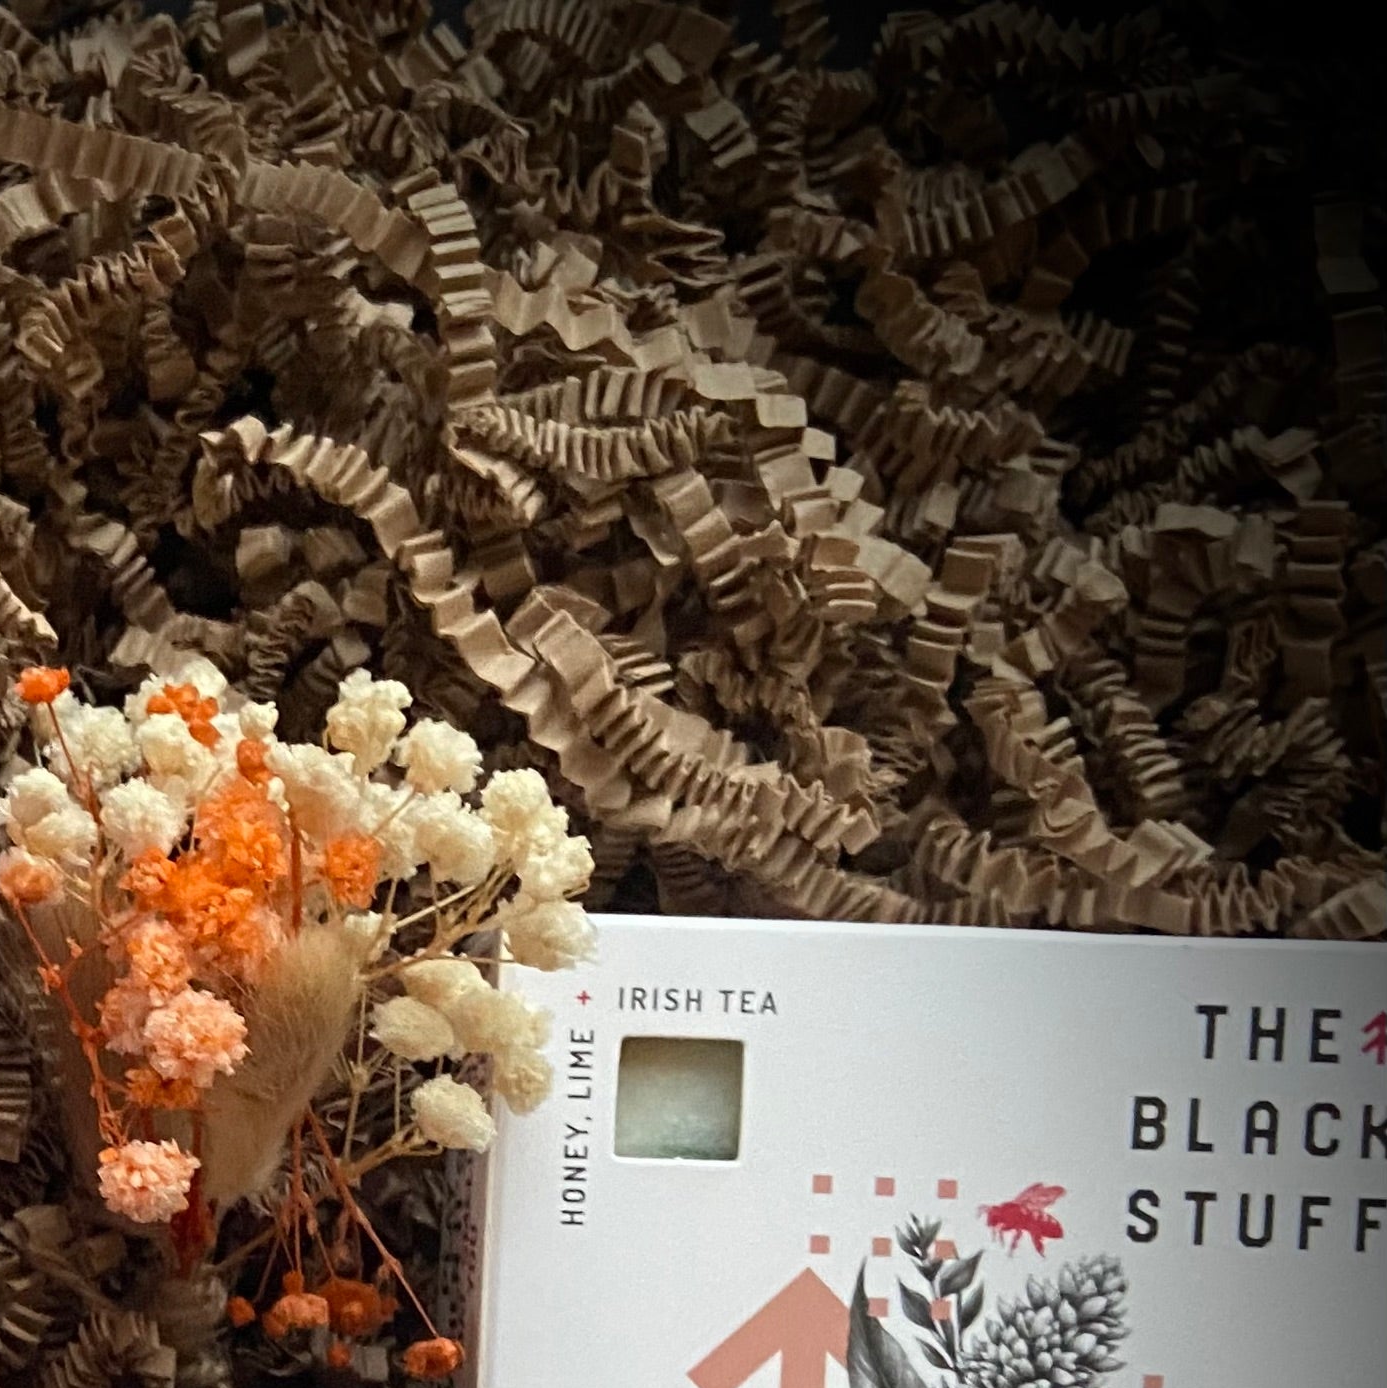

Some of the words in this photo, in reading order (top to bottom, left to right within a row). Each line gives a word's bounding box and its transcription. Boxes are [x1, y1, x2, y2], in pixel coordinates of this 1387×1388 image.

[618, 987, 702, 1012] IRISH
[719, 990, 778, 1015] TEA
[568, 1029, 595, 1100] LIME
[1195, 1005, 1342, 1063] THE
[1131, 1096, 1387, 1159] BLACK
[561, 1116, 593, 1226] HONEY,
[1126, 1189, 1387, 1252] STUFF
